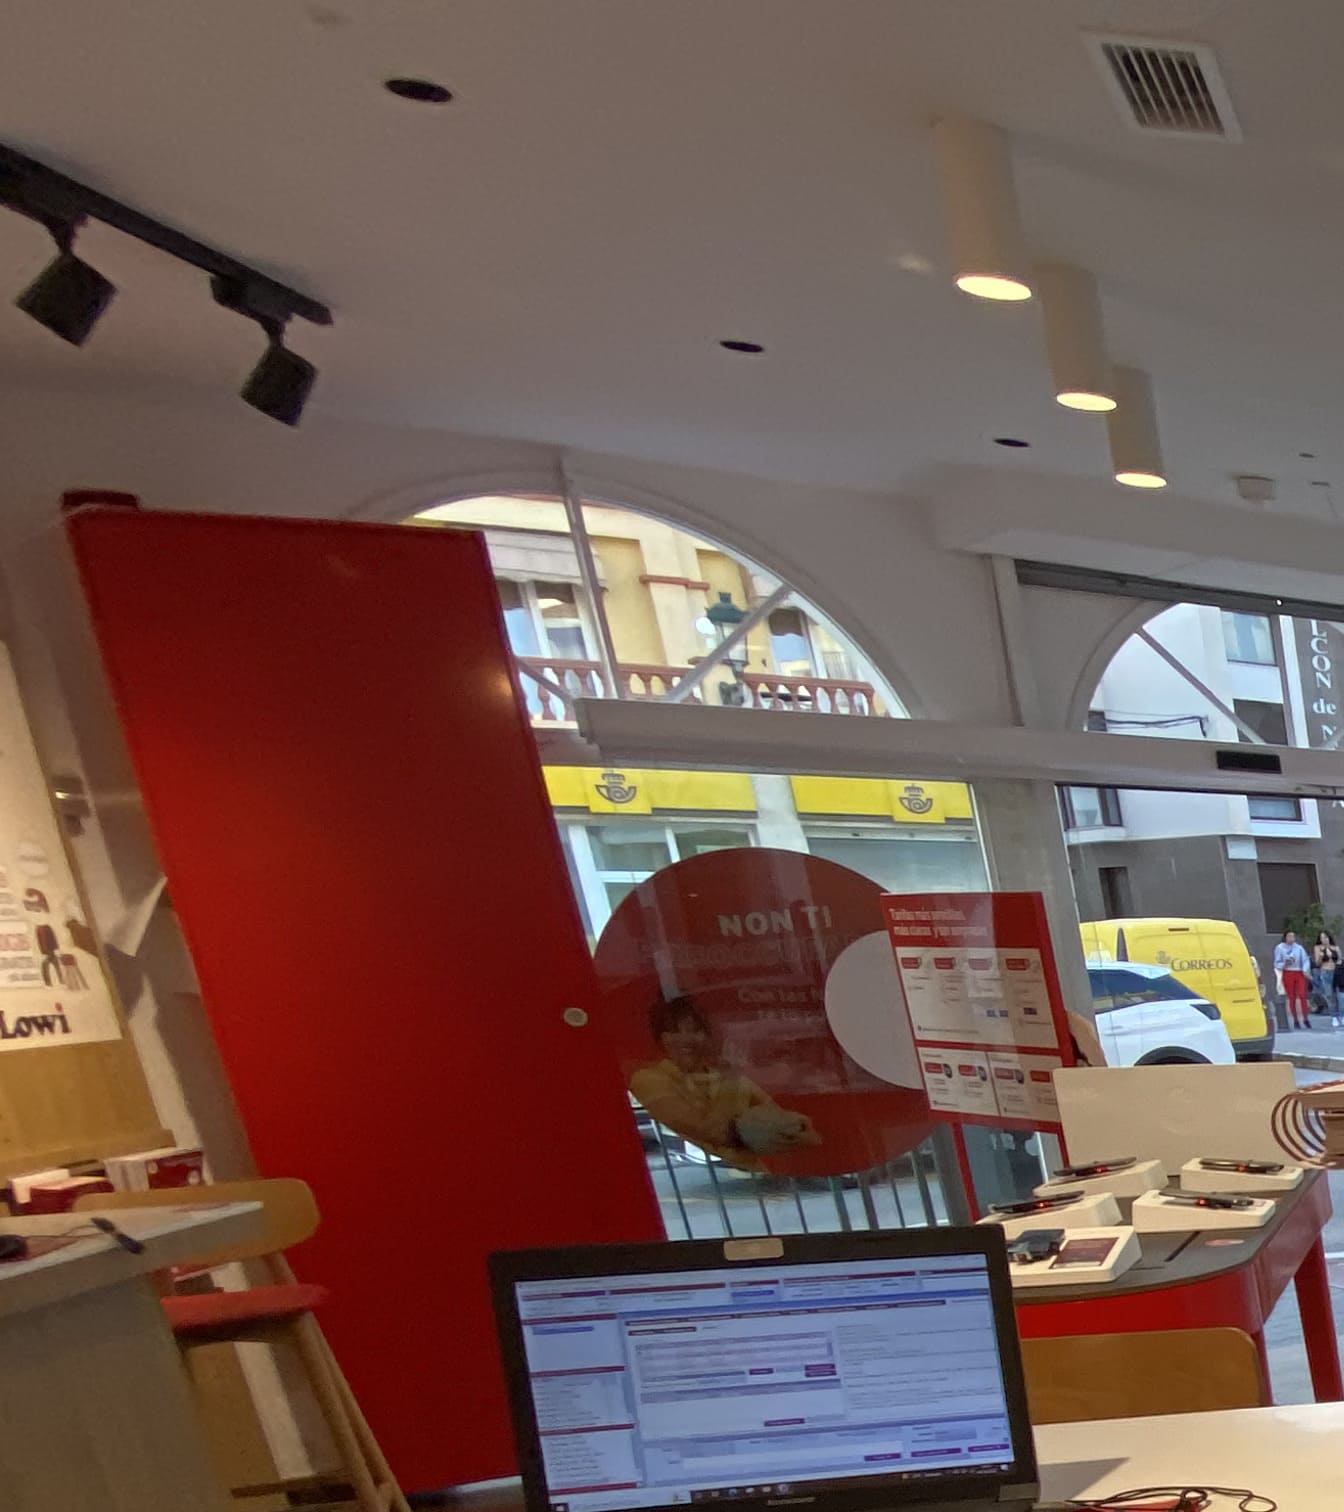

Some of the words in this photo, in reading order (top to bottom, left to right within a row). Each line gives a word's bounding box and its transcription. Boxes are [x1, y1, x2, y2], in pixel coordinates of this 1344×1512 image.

[1312, 697, 1337, 716] de
[717, 907, 795, 938] NON
[801, 903, 833, 929] TI
[1170, 958, 1233, 972] CORREOS
